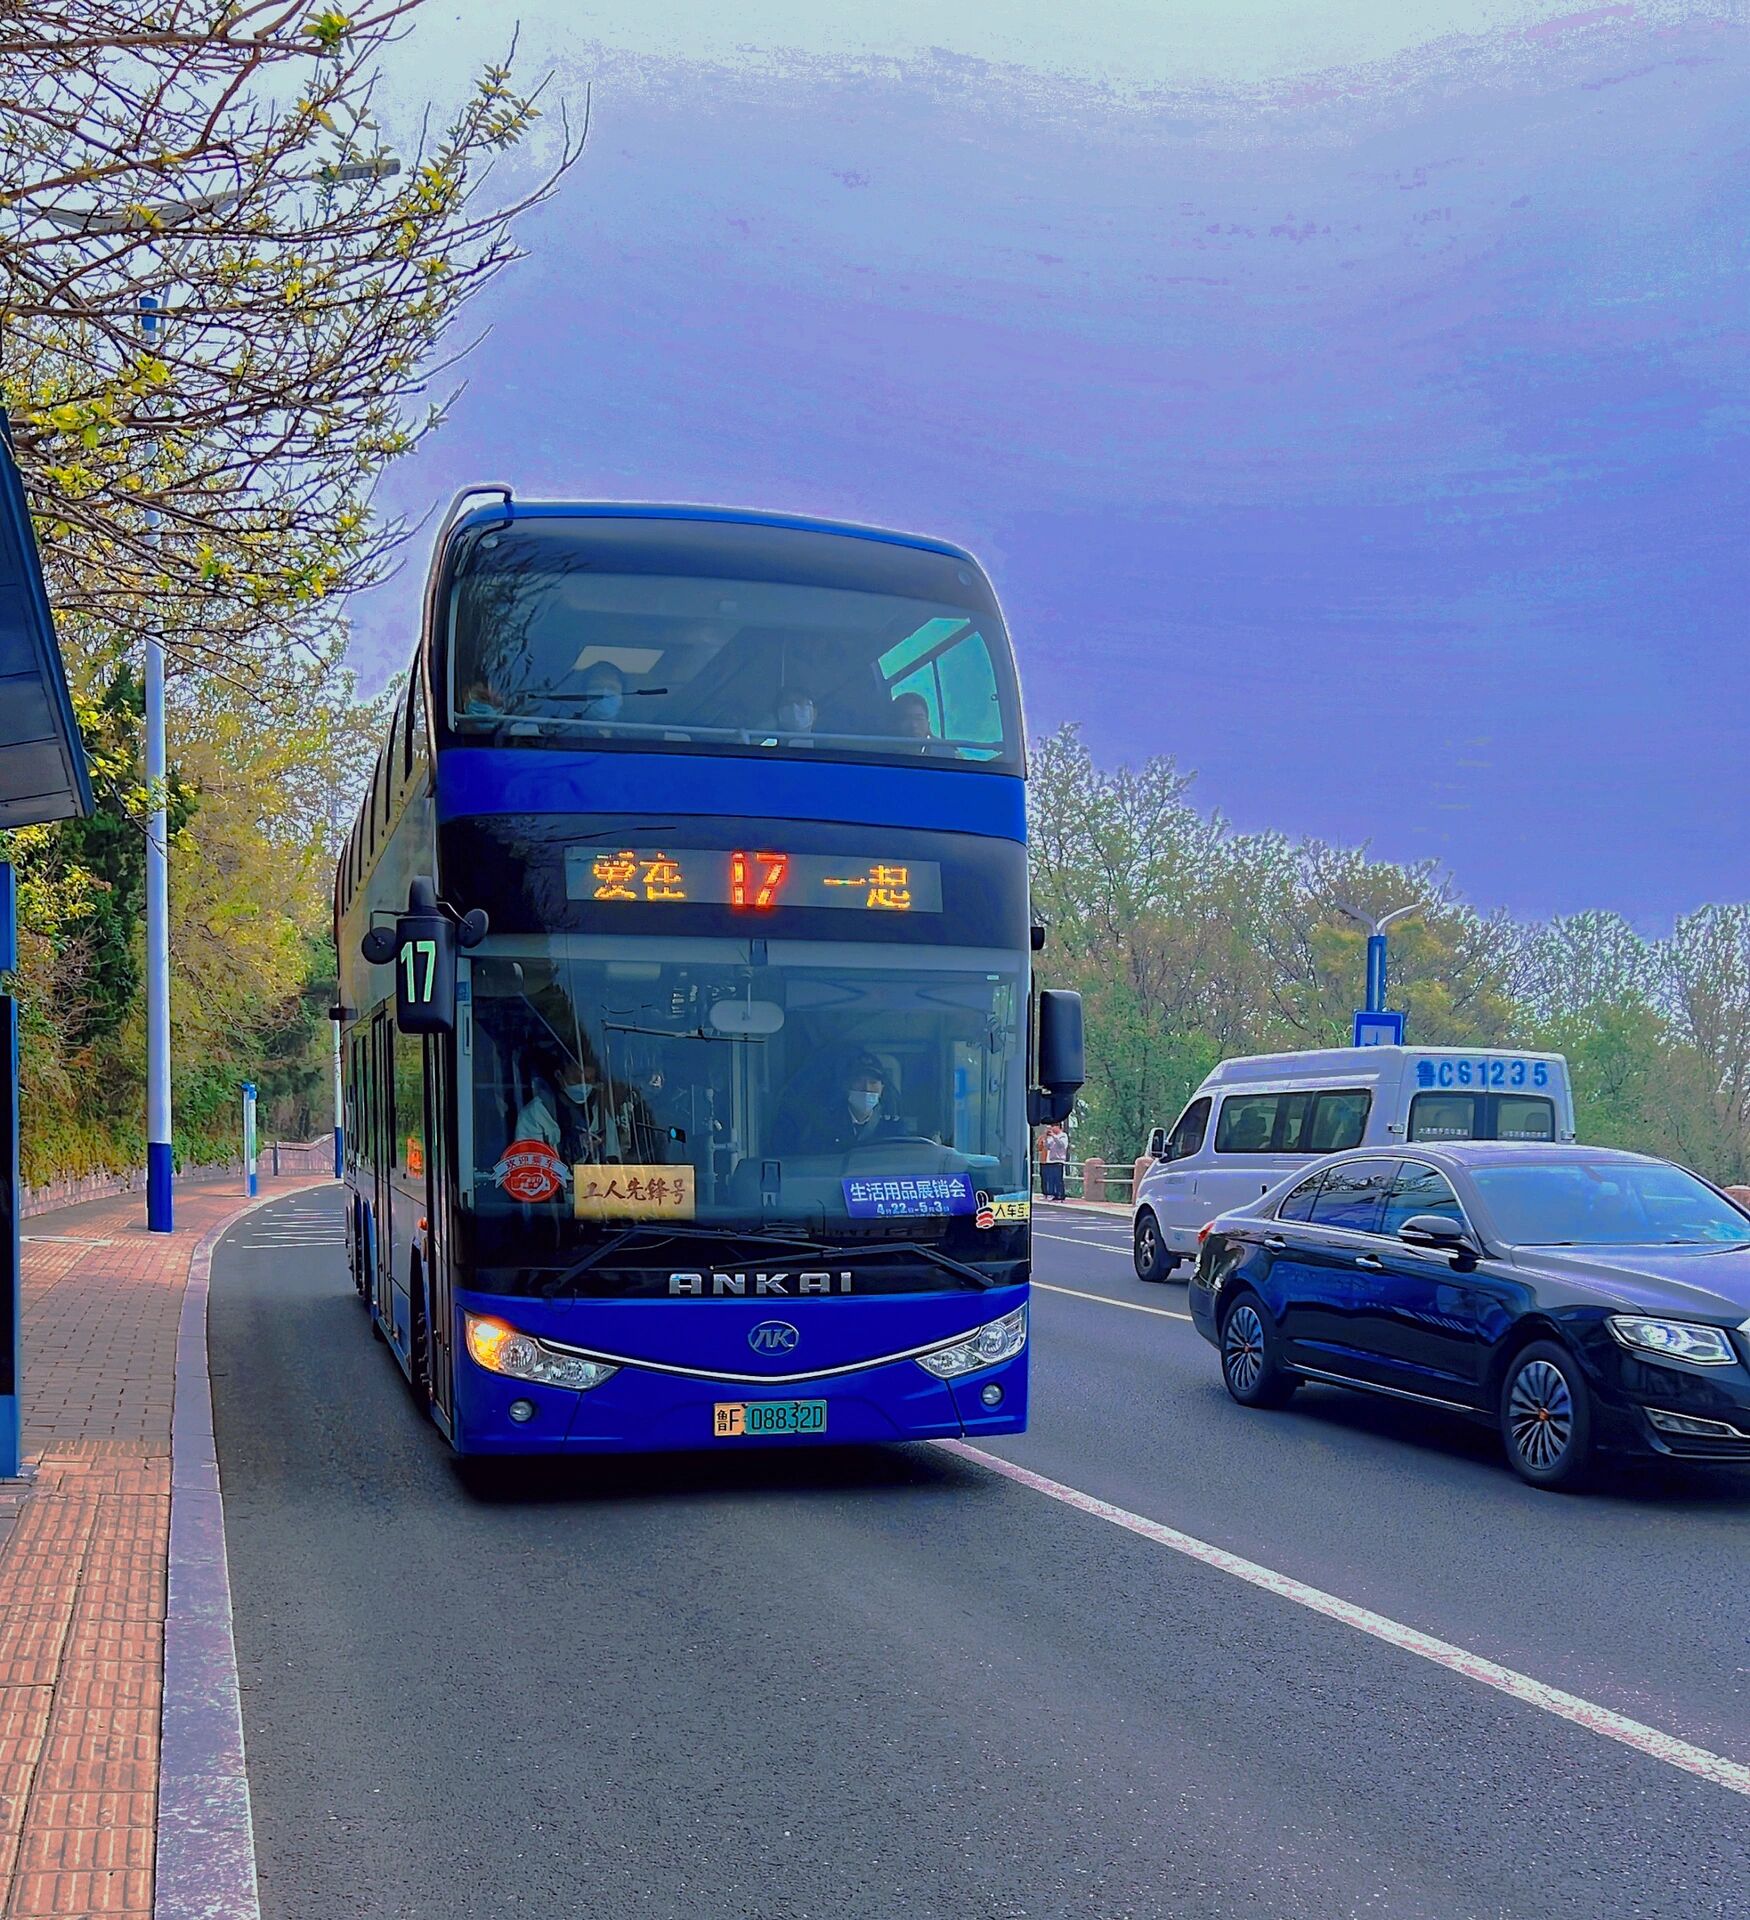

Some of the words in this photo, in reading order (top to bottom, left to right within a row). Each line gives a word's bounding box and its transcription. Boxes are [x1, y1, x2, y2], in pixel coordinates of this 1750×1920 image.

[732, 850, 789, 907] 17
[400, 940, 436, 1003] 17
[851, 1178, 966, 1202] 生活用品展销会
[668, 1272, 852, 1294] ANKAI
